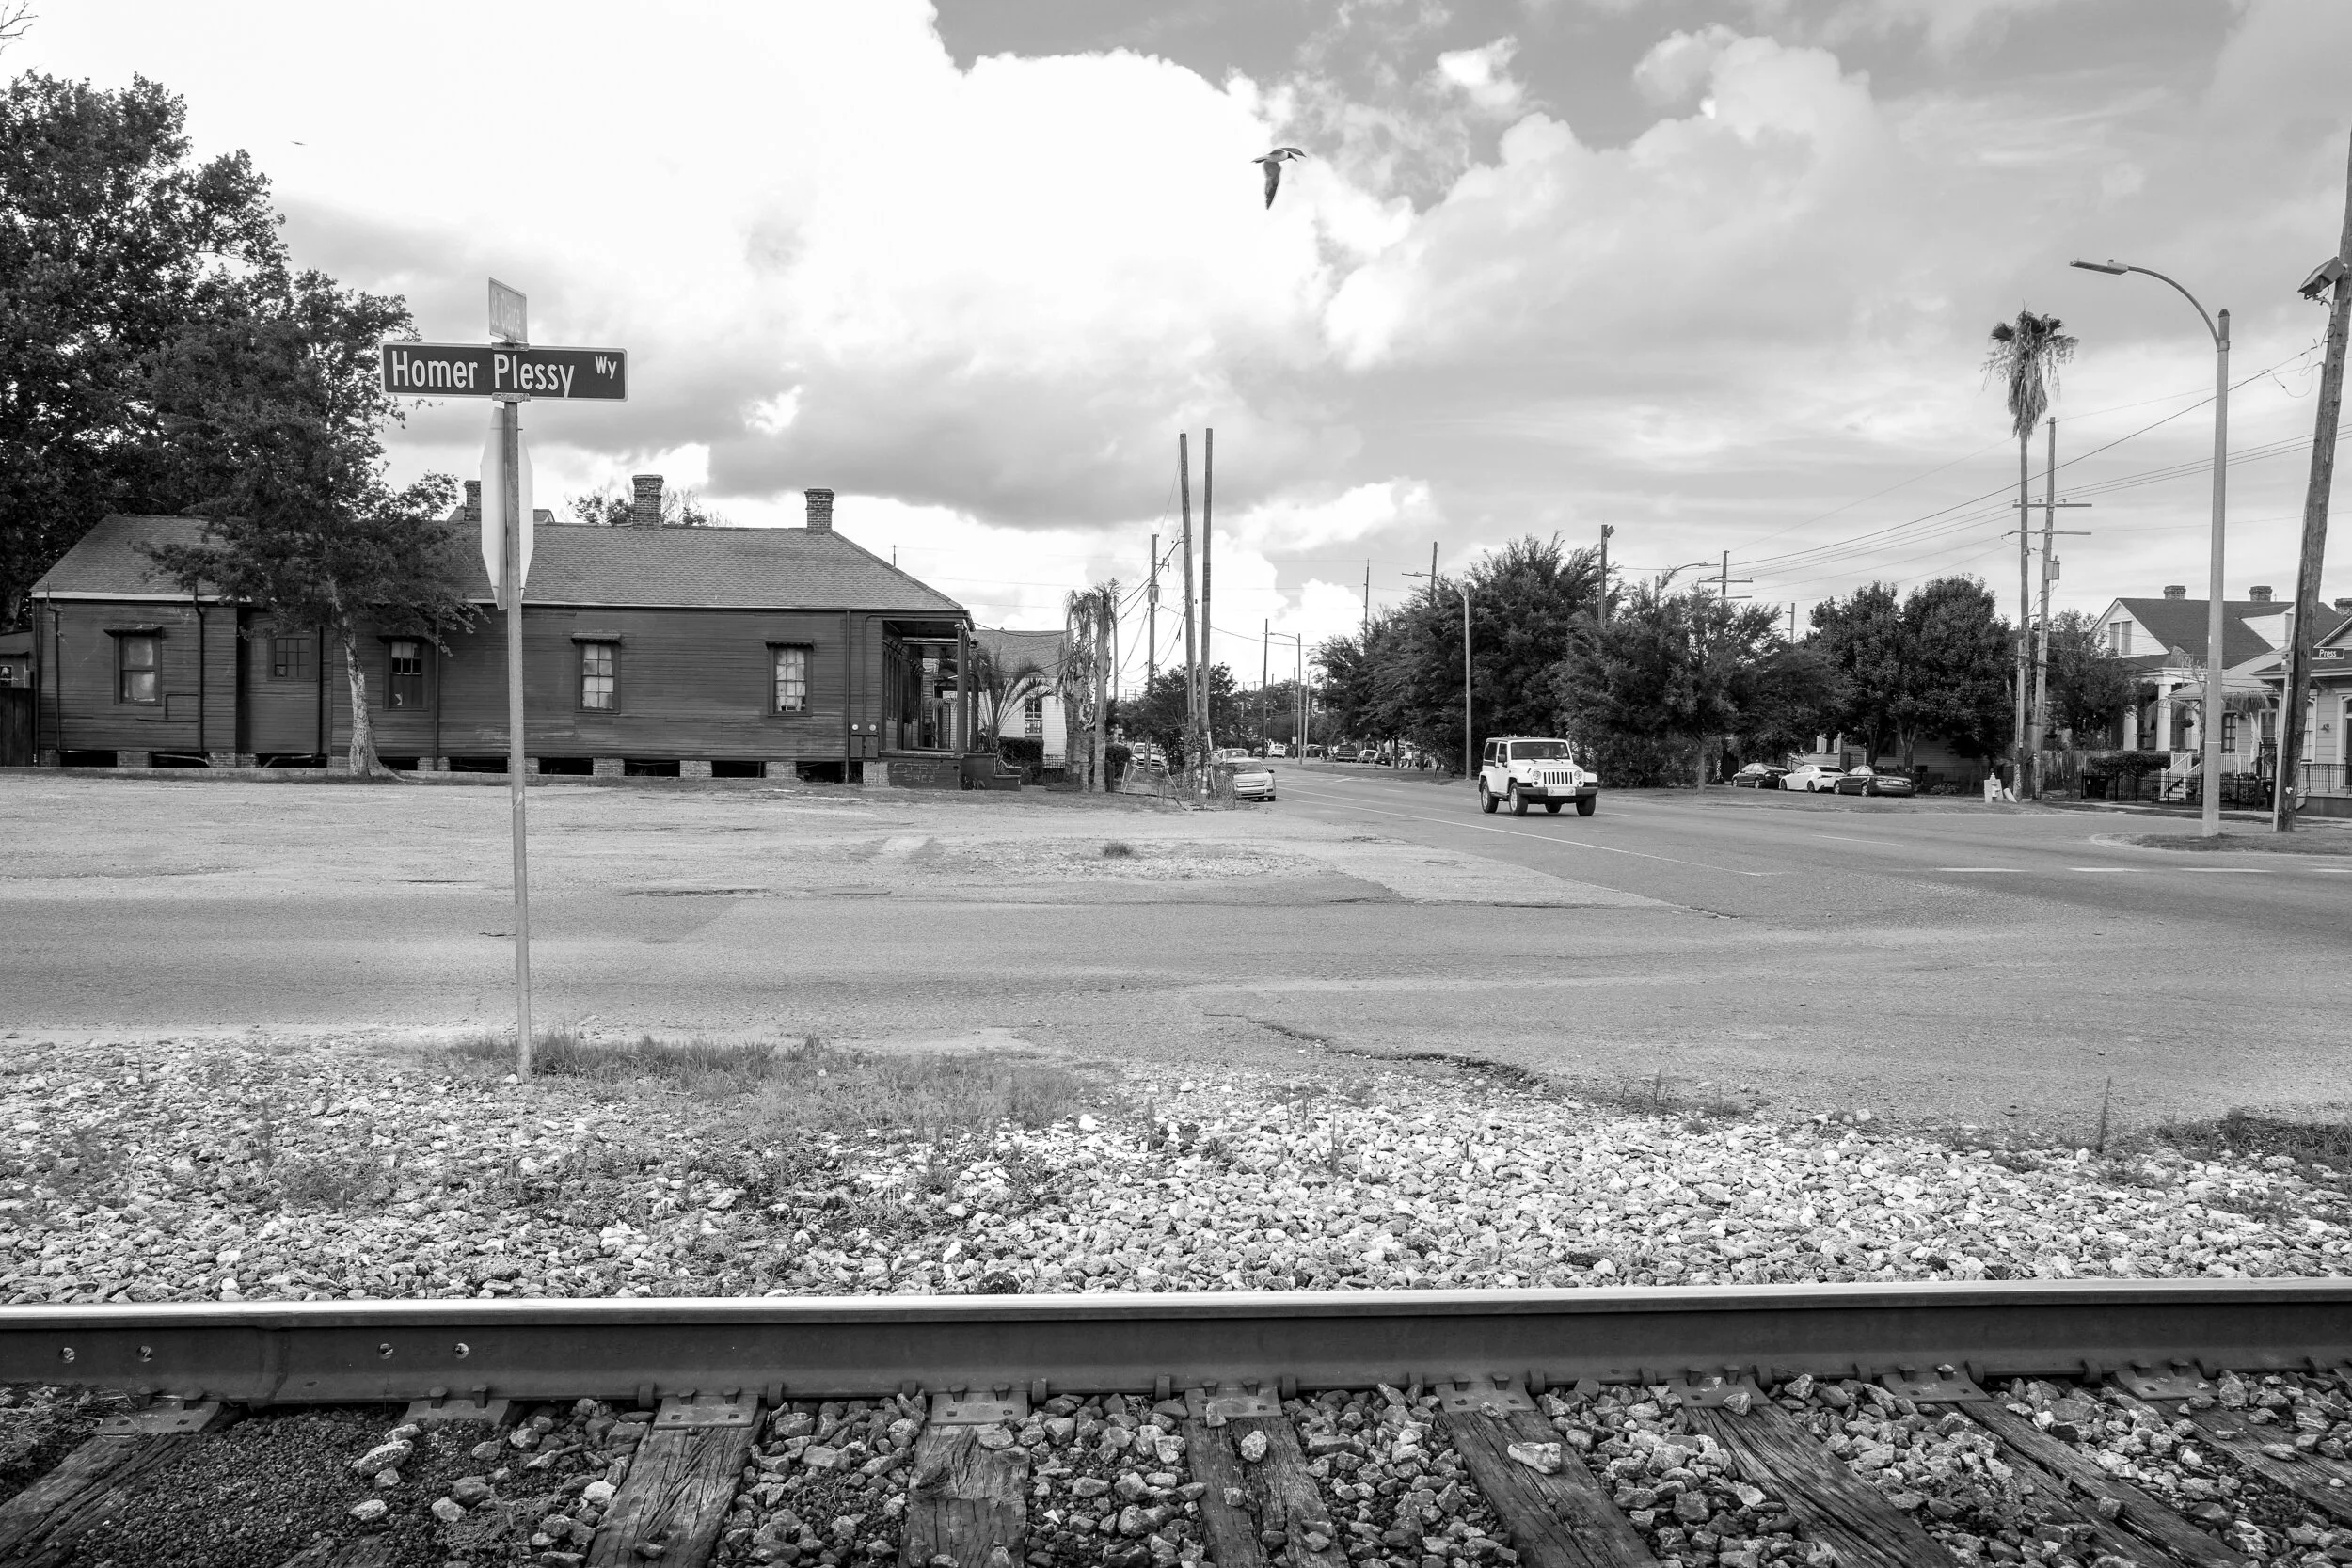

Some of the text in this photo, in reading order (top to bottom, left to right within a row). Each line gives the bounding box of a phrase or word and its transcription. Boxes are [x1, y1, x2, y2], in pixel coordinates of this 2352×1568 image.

[391, 350, 617, 398] Homer Plessy Wy
[2318, 649, 2337, 657] Press
